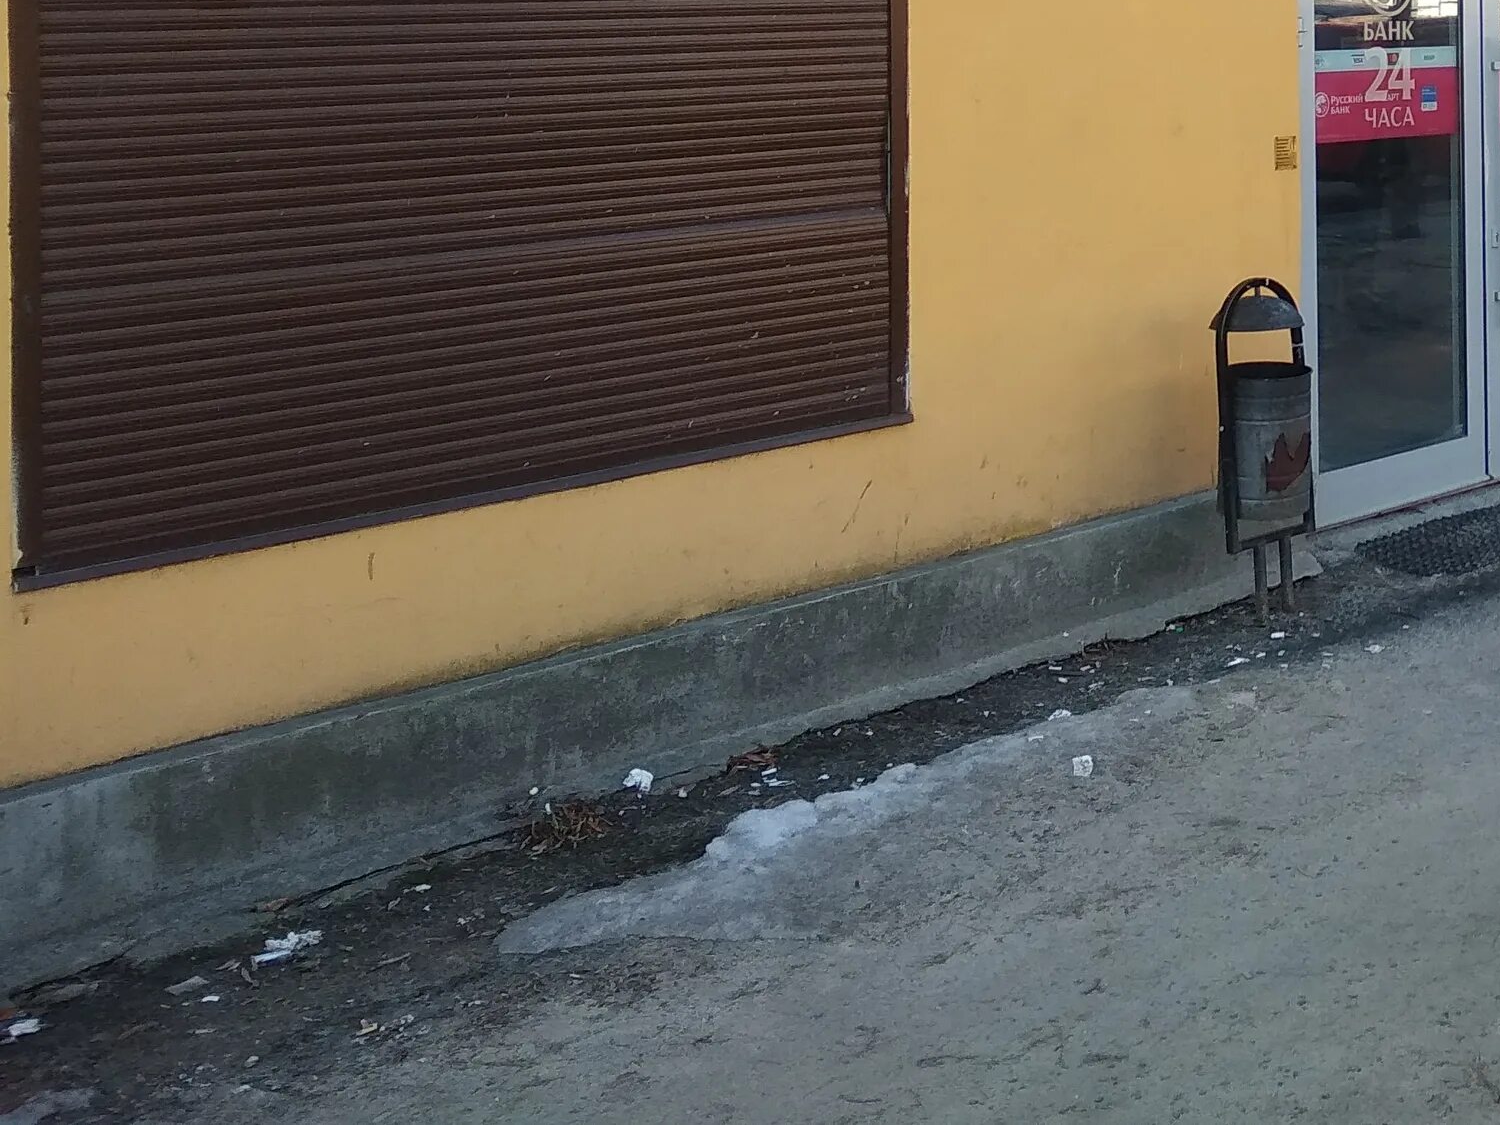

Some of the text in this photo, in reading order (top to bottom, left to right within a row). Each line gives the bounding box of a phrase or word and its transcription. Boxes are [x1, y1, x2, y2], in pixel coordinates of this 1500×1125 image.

[1363, 20, 1415, 41] БАНК
[1364, 46, 1416, 102] 24
[1330, 106, 1351, 115] БАНК
[1364, 106, 1415, 128] ЧАСА
